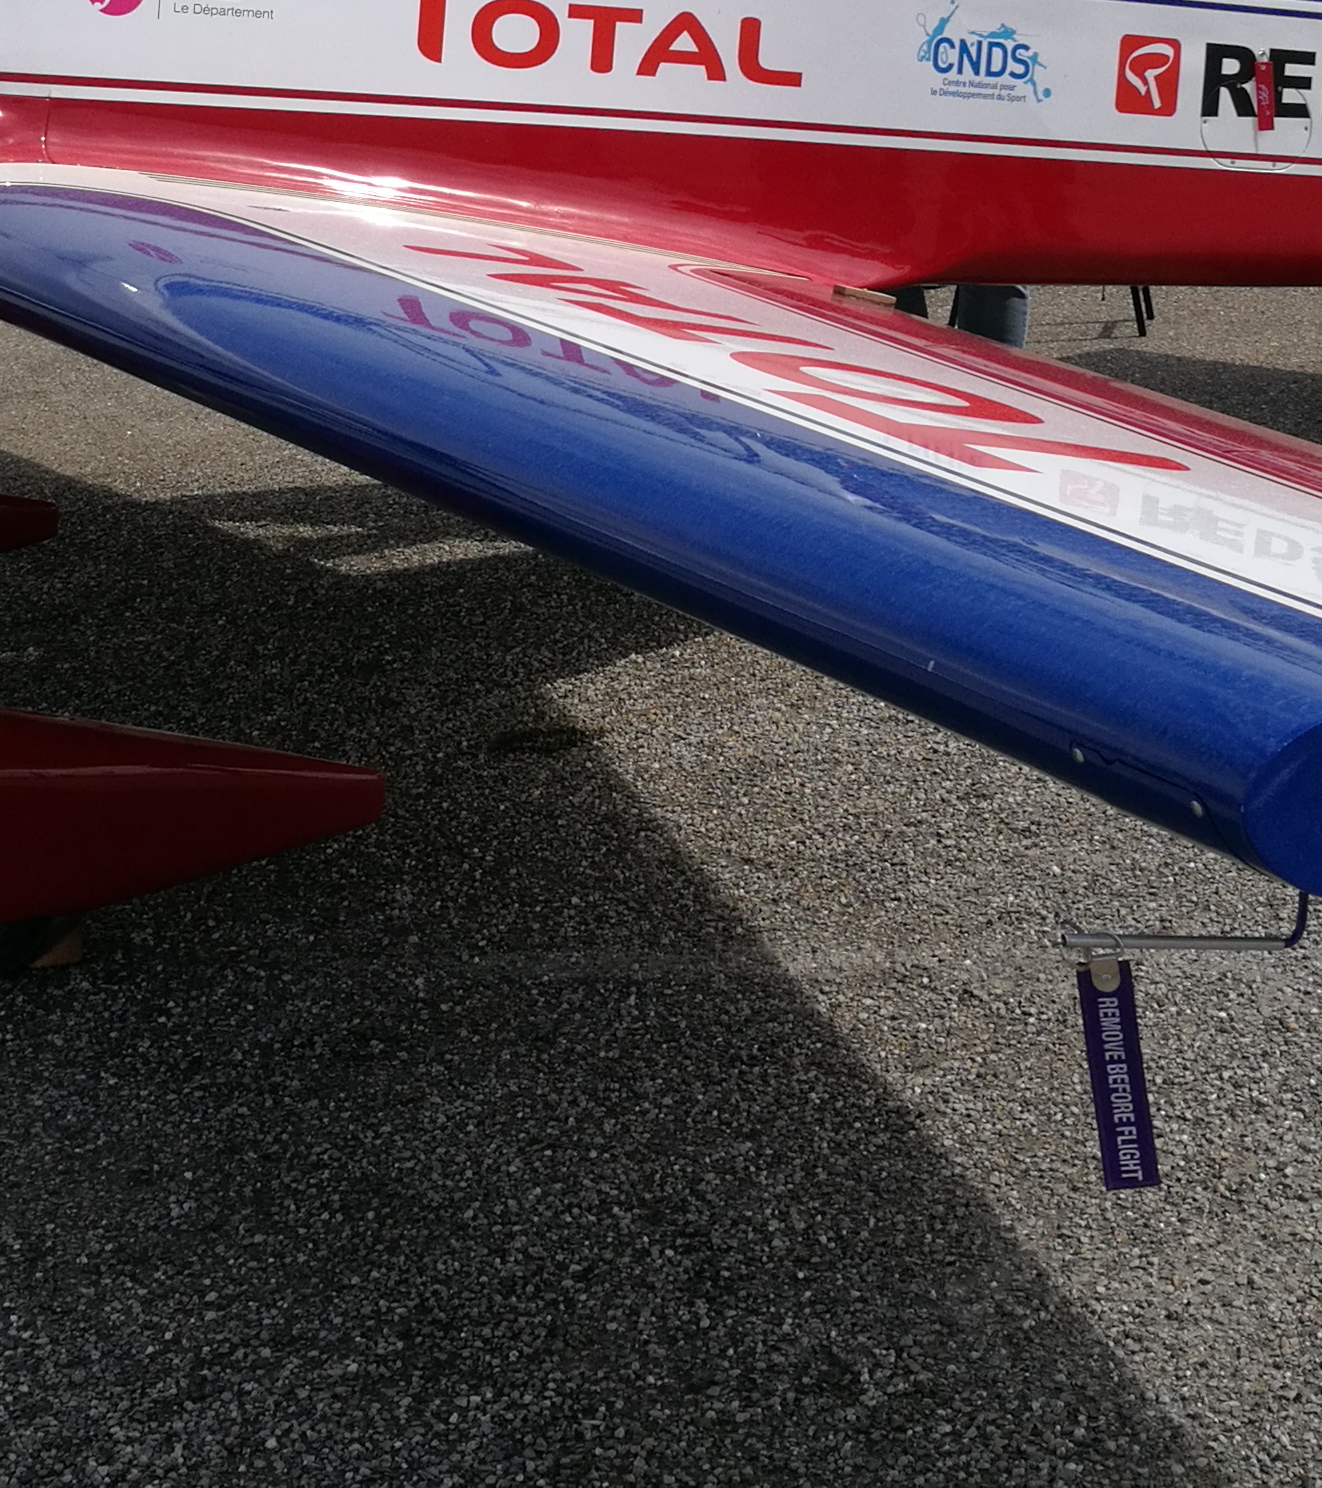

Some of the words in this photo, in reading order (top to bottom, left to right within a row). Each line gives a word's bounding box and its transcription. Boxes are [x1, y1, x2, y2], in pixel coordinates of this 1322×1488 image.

[173, 2, 189, 14] Le
[193, 3, 274, 19] Département
[932, 37, 1031, 80] CNDS
[942, 78, 967, 87] Centre
[968, 79, 998, 90] National
[999, 82, 1017, 91] pour
[1006, 93, 1027, 103] Sport
[1097, 997, 1126, 1060] REMOVE
[1107, 1062, 1135, 1122] BEFORE
[1115, 1124, 1144, 1181] FLIGHT
